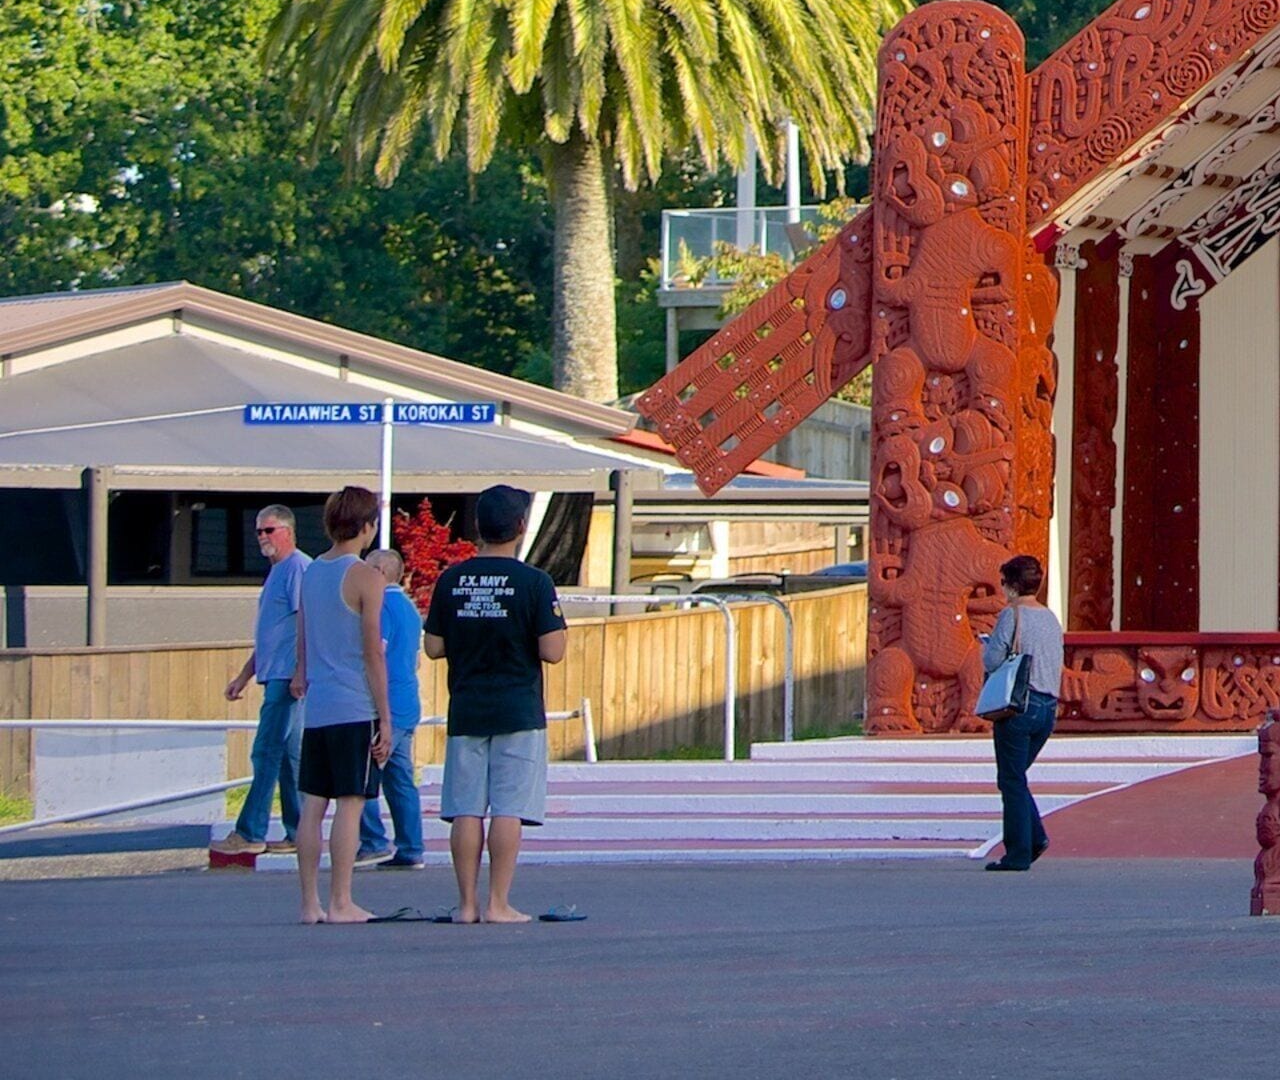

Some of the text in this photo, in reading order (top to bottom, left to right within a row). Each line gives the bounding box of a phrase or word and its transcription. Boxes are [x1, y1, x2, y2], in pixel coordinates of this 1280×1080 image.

[250, 405, 377, 421] MATAIAWHEA ST
[398, 405, 490, 421] KOROKAI ST
[480, 575, 509, 587] NAVY
